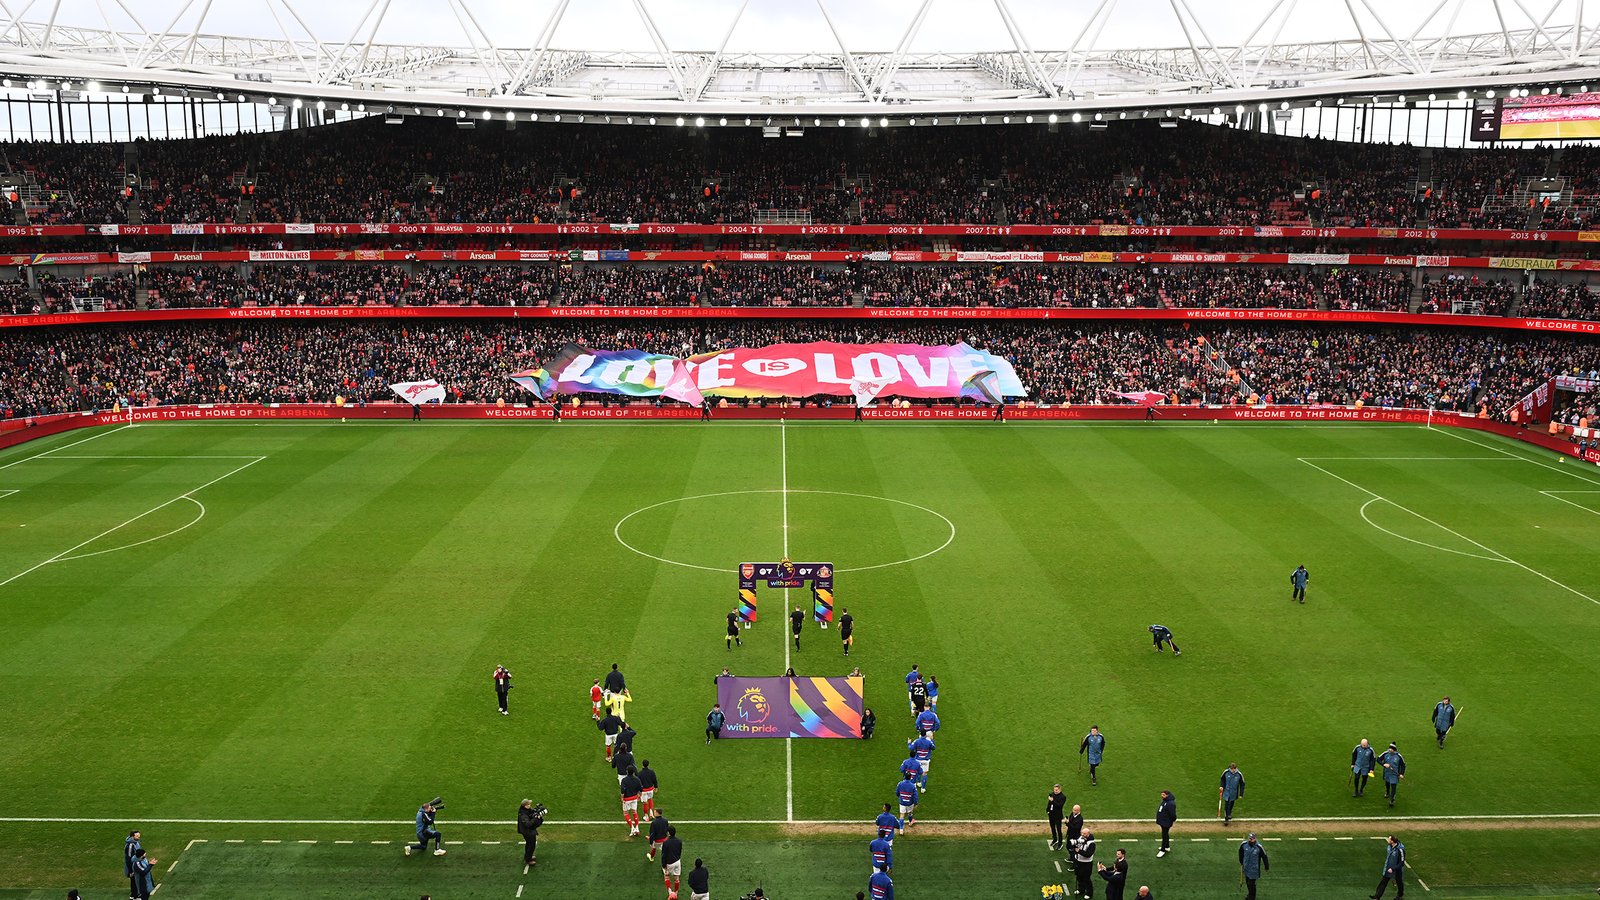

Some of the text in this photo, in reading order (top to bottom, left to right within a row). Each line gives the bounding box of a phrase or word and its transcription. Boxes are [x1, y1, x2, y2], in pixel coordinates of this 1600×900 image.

[173, 253, 203, 261] Arsenal
[469, 252, 497, 260] Arsenal
[1384, 257, 1413, 265] Arsenal
[1500, 259, 1555, 269] AUSTRALIA
[32, 315, 81, 324] ARSENAL
[1526, 321, 1578, 330] WELCOME
[557, 352, 990, 391] LOVE IS LOVE
[101, 411, 158, 423] WELCOME
[1328, 411, 1359, 419] HOME
[1381, 412, 1401, 420] THE
[1405, 413, 1459, 425] ARSENAL
[1573, 446, 1600, 461] WLCO
[914, 687, 925, 696] 22
[617, 701, 621, 709] 1
[726, 723, 781, 734] with pride.
